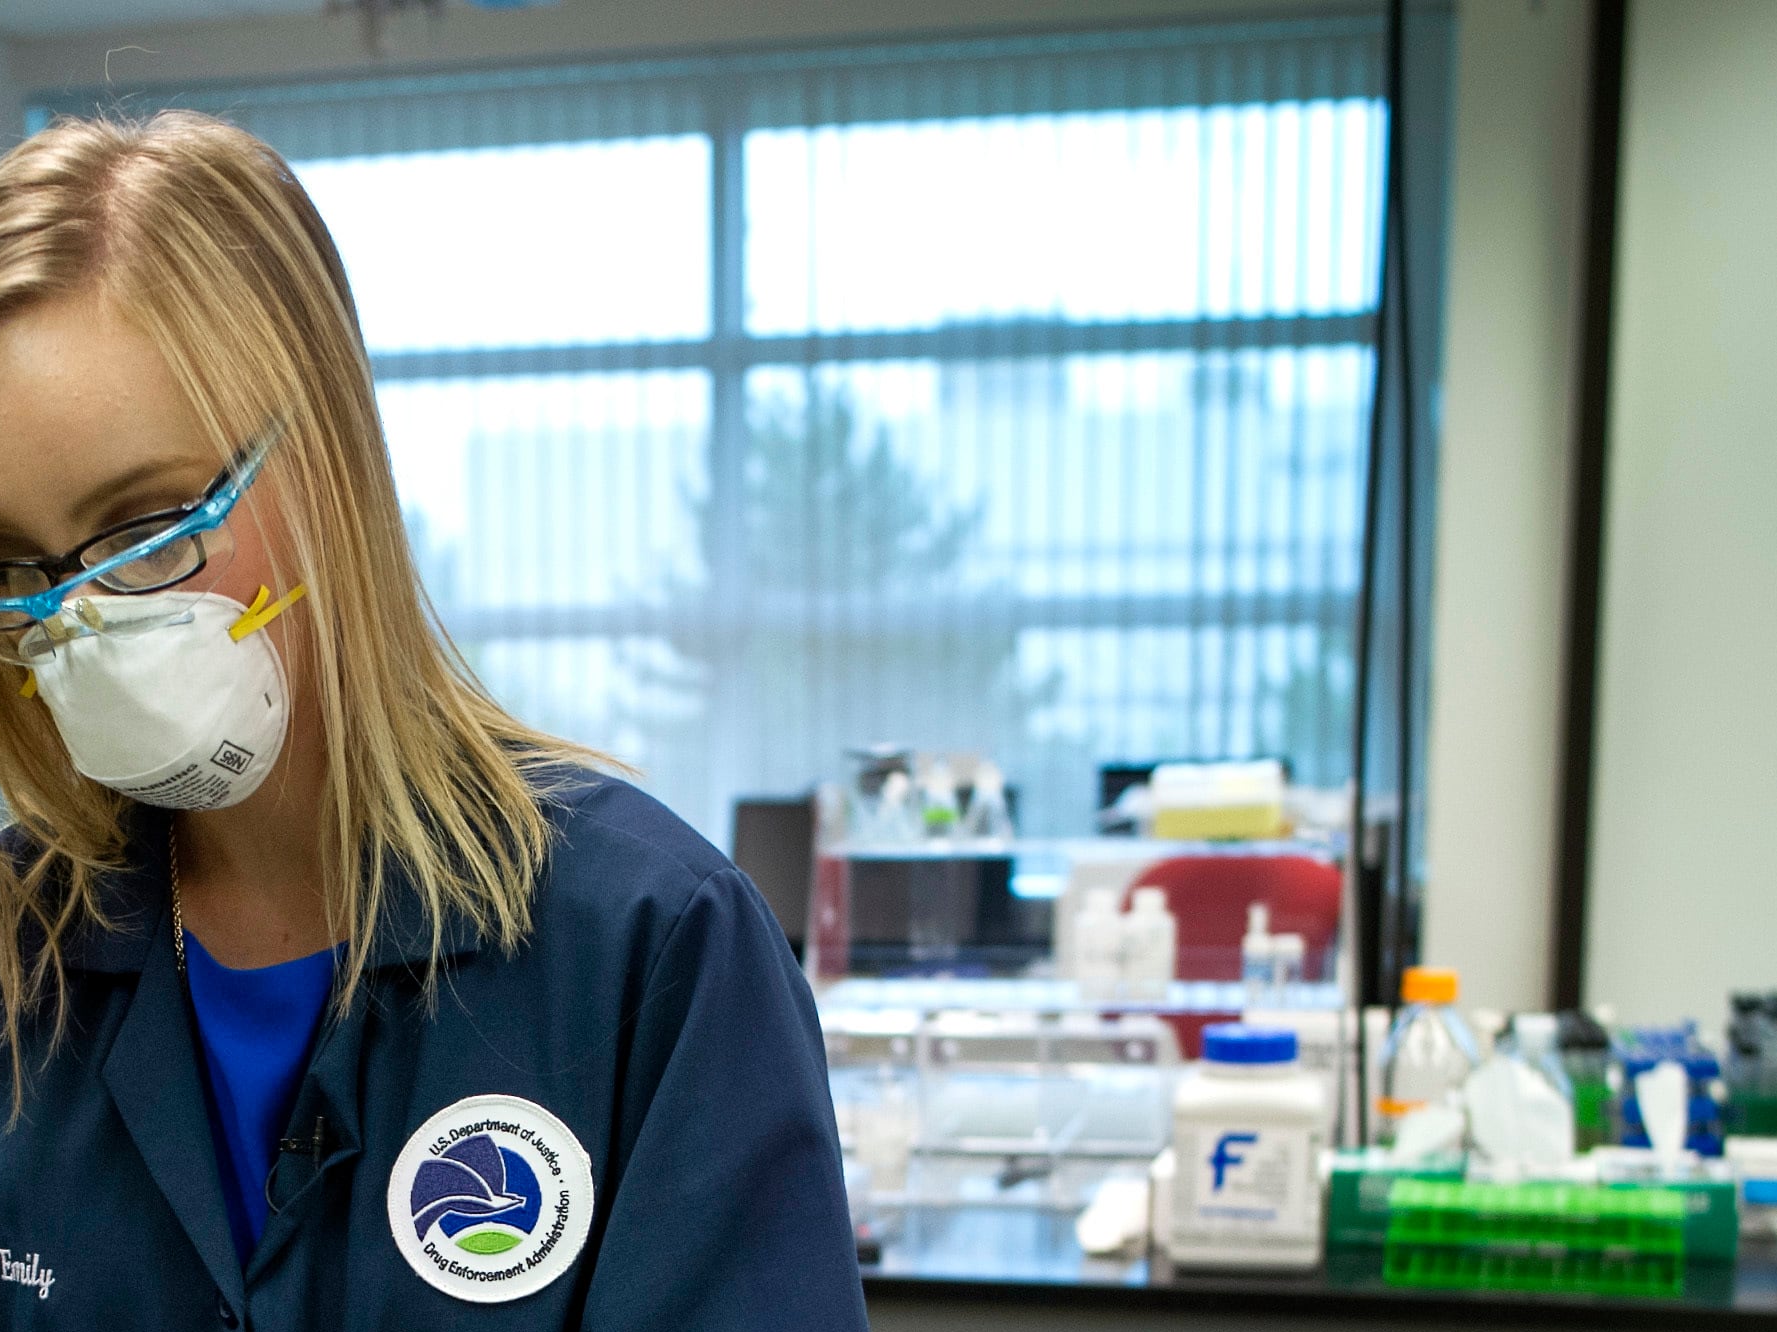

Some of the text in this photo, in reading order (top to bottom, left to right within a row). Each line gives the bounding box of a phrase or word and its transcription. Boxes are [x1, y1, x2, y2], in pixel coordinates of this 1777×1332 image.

[220, 750, 246, 770] N95
[450, 1118, 520, 1142] Department
[520, 1127, 533, 1141] of
[532, 1133, 561, 1177] Justice
[423, 1189, 570, 1282] Drug Enforcement Administration
